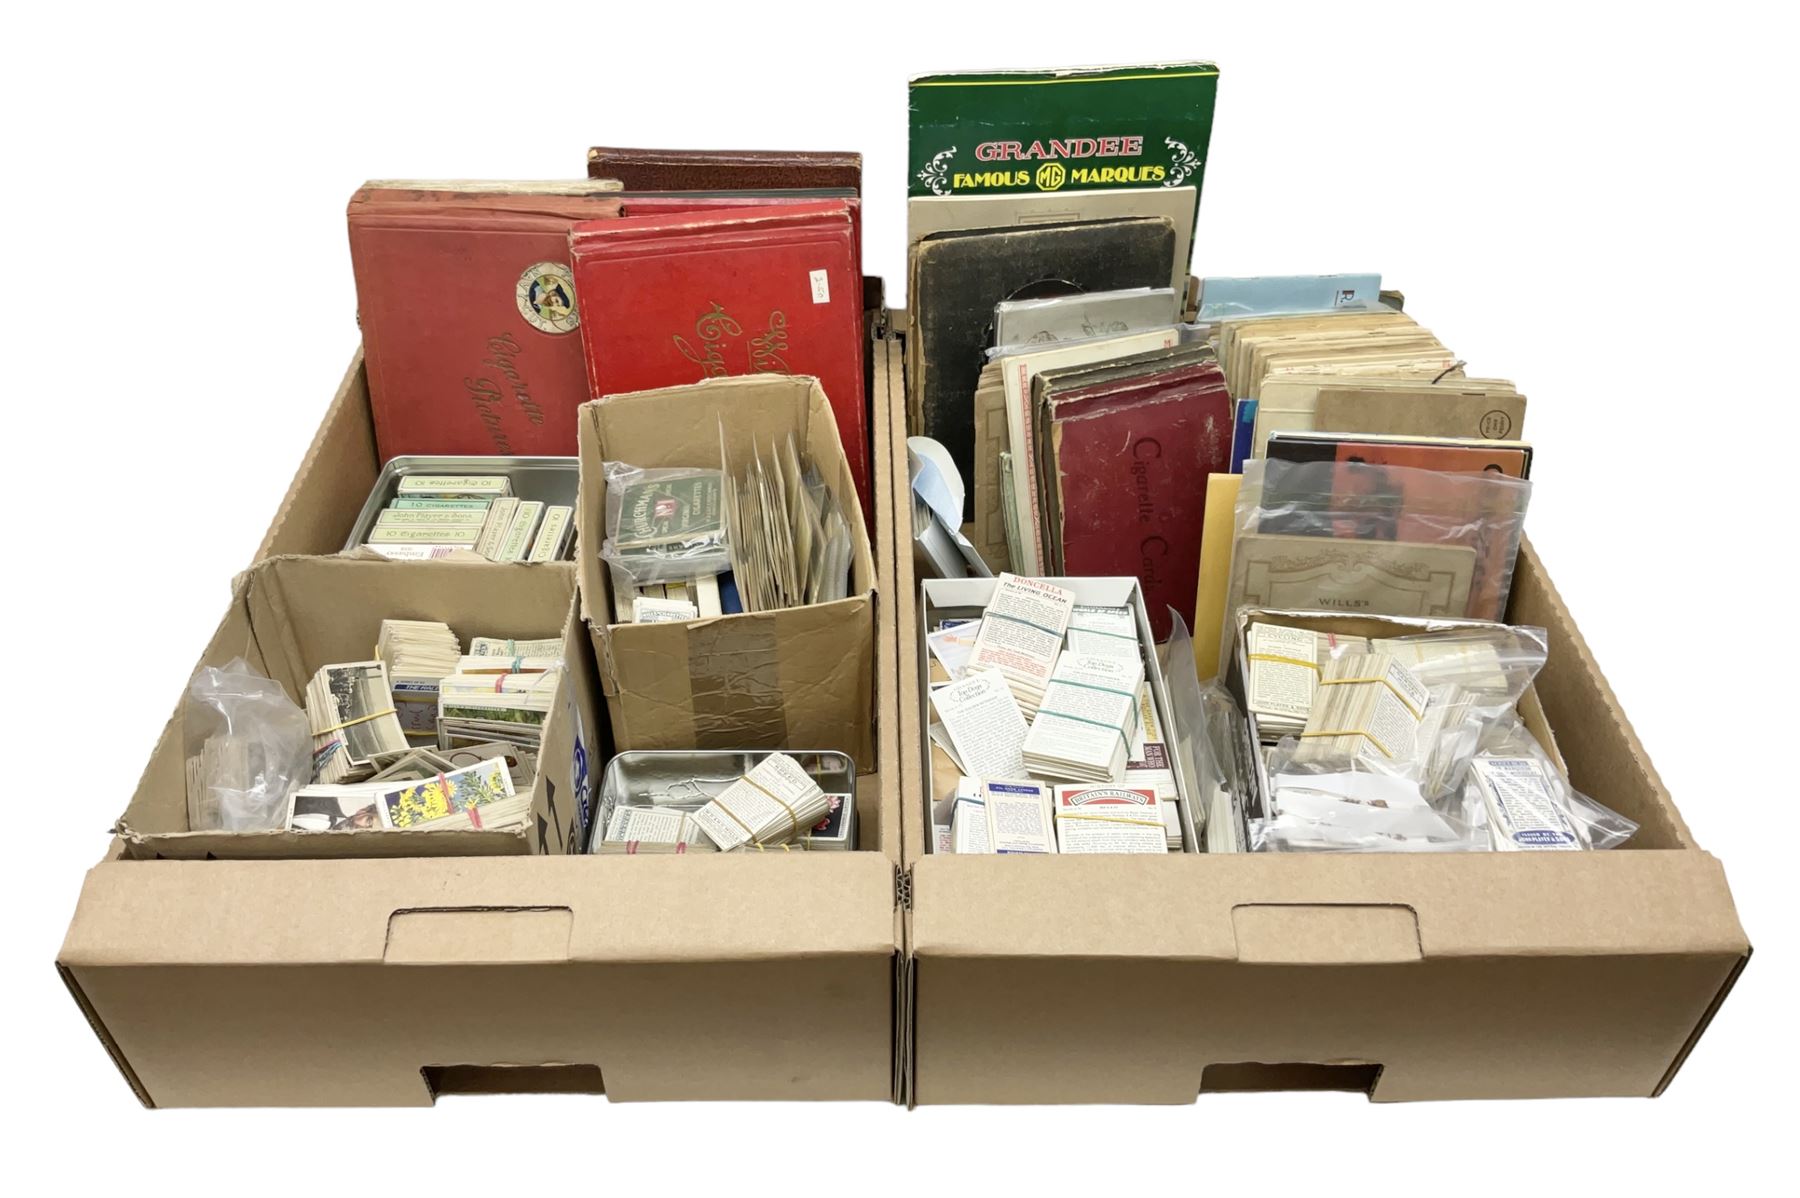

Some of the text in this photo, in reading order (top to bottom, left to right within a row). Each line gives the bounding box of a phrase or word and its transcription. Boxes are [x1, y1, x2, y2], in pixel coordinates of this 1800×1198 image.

[975, 136, 1144, 161] GRANDEE
[953, 165, 1166, 189] FAMOUS MG MARQUES
[483, 332, 546, 426] Cigarette
[1131, 437, 1162, 524] Cigarette
[1003, 582, 1067, 604] The LIVING OCEAN
[1013, 576, 1063, 596] DONCELLA
[1152, 745, 1164, 768] FOR THE
[1074, 790, 1144, 803] BRITAIN'S RAILWAYS
